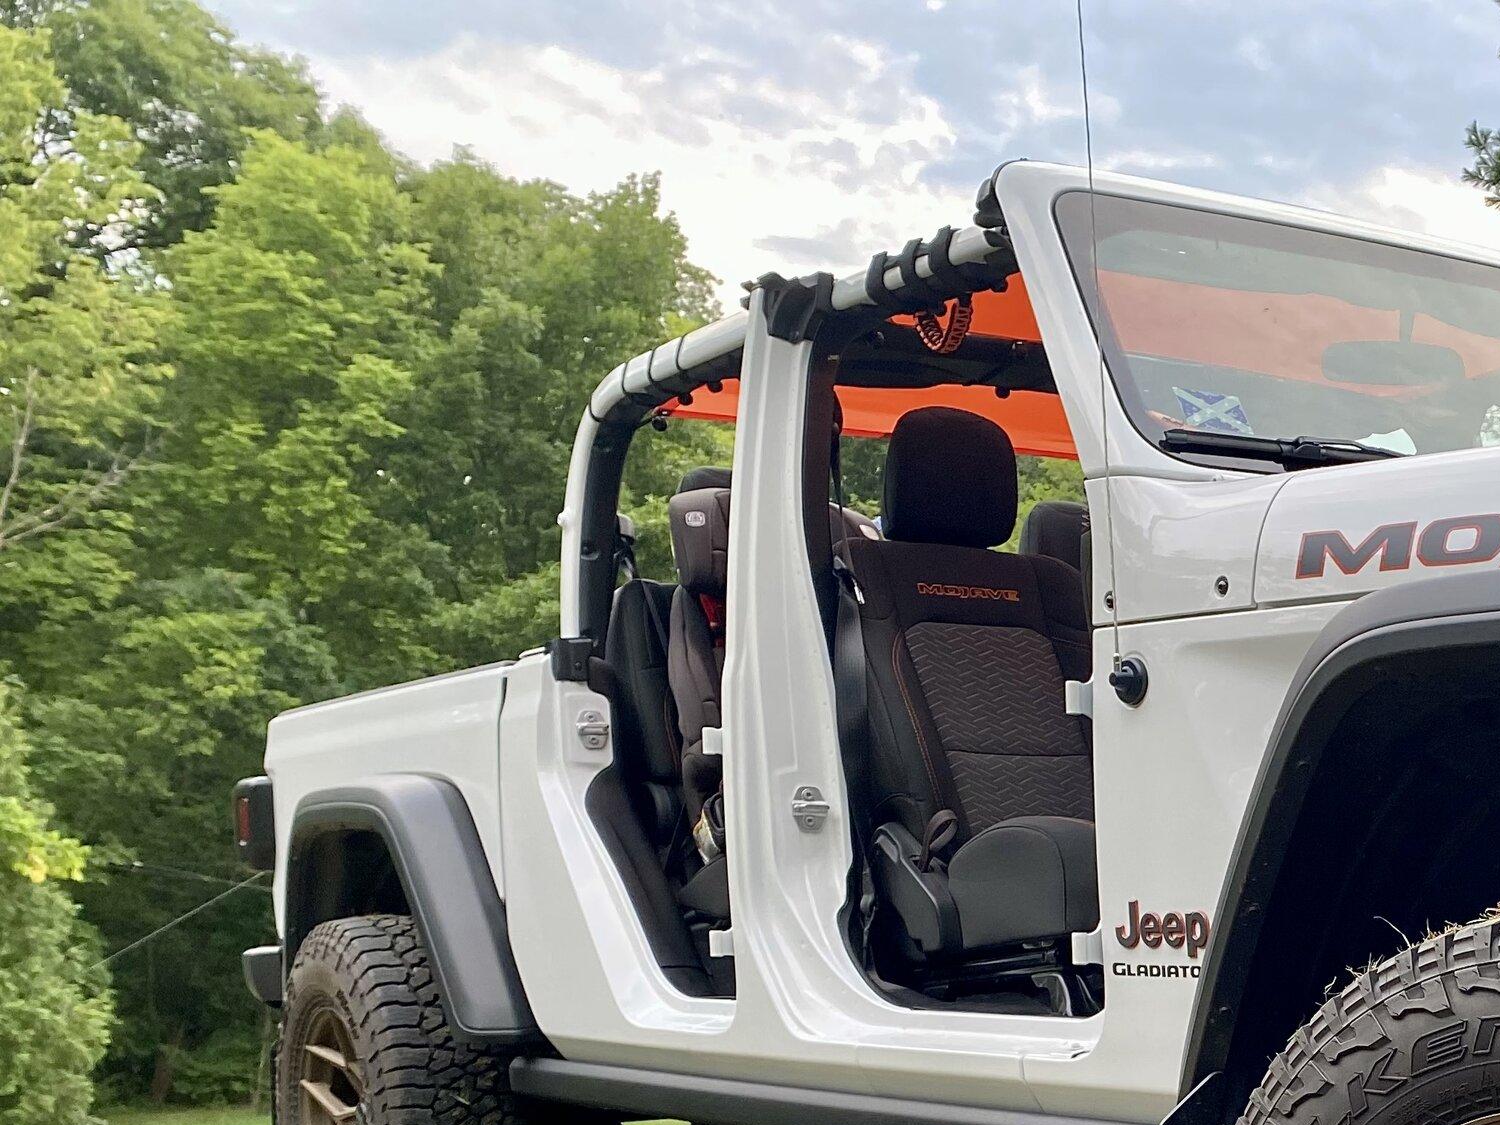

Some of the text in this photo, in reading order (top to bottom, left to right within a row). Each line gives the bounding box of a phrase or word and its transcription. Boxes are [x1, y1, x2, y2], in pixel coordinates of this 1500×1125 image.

[917, 582, 1020, 602] MOJAVE
[1115, 898, 1210, 959] Jeep
[1112, 962, 1202, 979] GLADIATO
